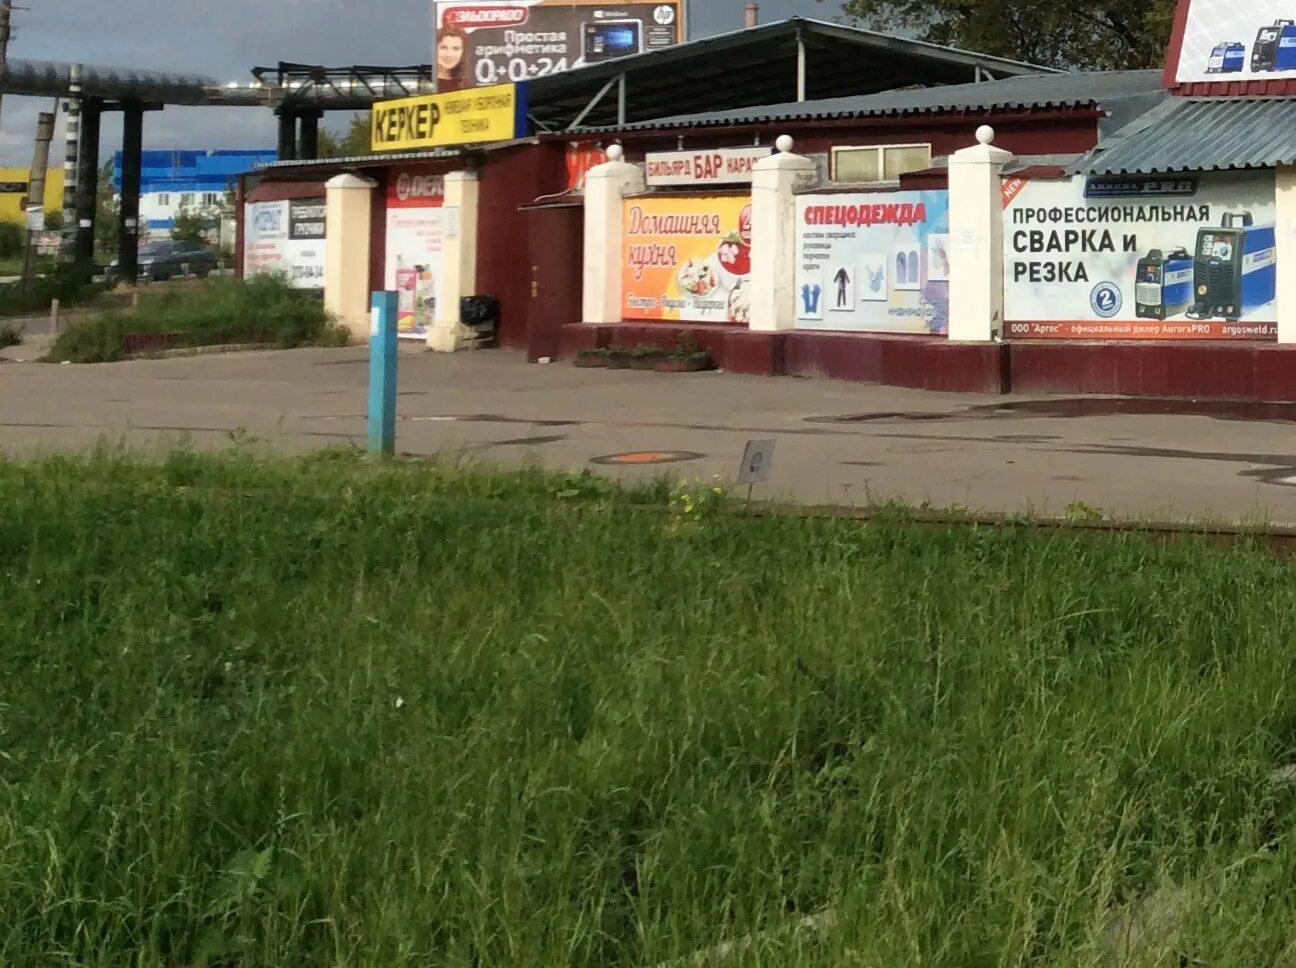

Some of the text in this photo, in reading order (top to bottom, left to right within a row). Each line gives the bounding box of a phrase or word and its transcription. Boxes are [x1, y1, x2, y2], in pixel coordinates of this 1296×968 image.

[503, 30, 568, 45] Простая
[474, 43, 568, 58] арифметика
[374, 102, 442, 143] КЕРХЕР
[648, 160, 692, 177] БИЛЬЯРД
[693, 154, 723, 180] БАР
[628, 205, 721, 235] Домашняя
[803, 202, 927, 227] СПЕЦОДЕЖДА
[1012, 204, 1210, 224] ПРОФЕССИОНАЛЬНАЯ
[1012, 229, 1115, 253] СВАРКА
[627, 243, 678, 280] кухня
[1013, 261, 1089, 282] РЕЗКА
[1011, 323, 1029, 333] ООО
[1070, 323, 1132, 334] официальный
